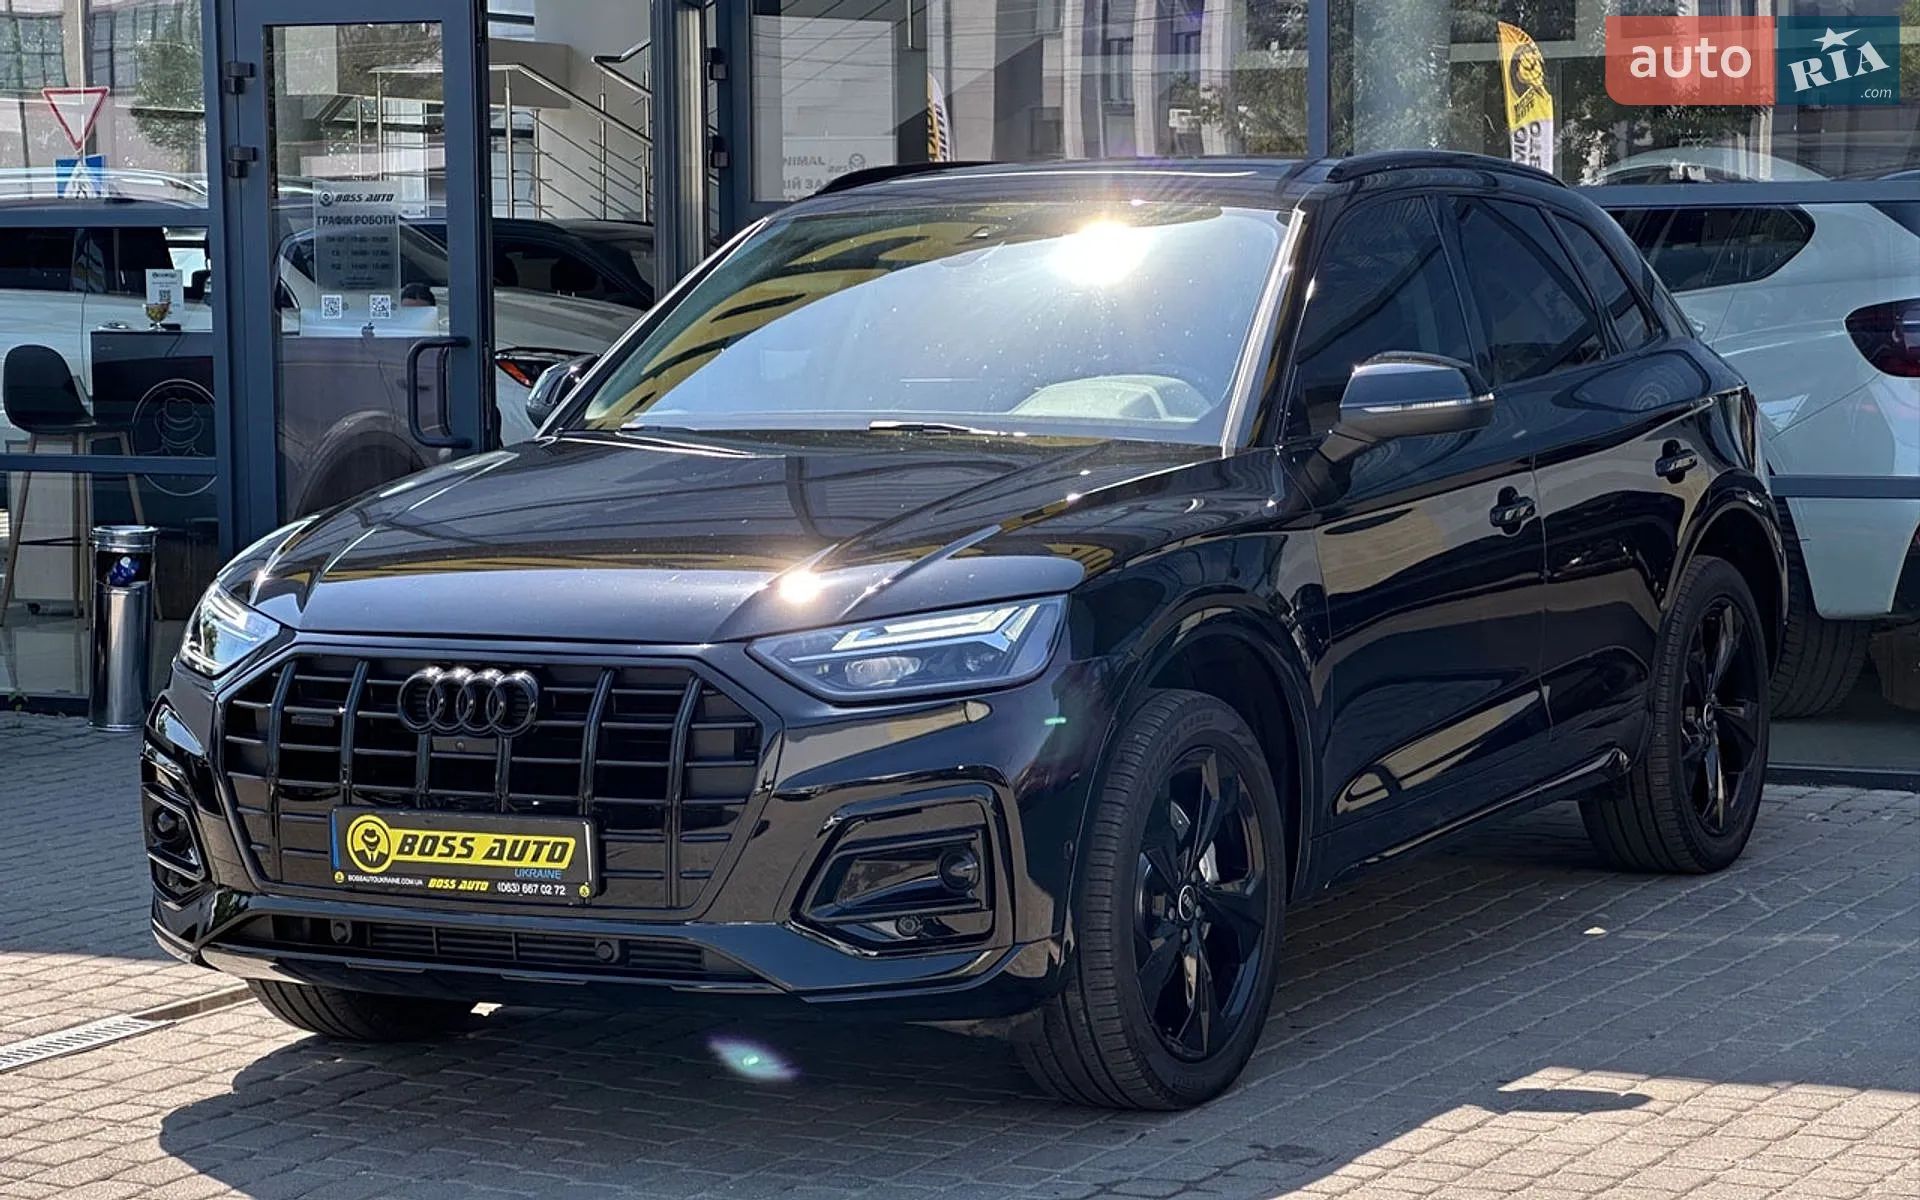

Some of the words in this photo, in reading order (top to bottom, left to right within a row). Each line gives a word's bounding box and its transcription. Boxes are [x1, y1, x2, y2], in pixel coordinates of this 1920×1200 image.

[354, 215, 396, 225] РОБОТИ
[396, 834, 476, 859] BOSS
[482, 838, 571, 863] AUTO
[514, 869, 562, 880] UKRAINE
[428, 878, 456, 889] BOSS
[458, 880, 489, 891] AUTO
[554, 885, 566, 896] 72
